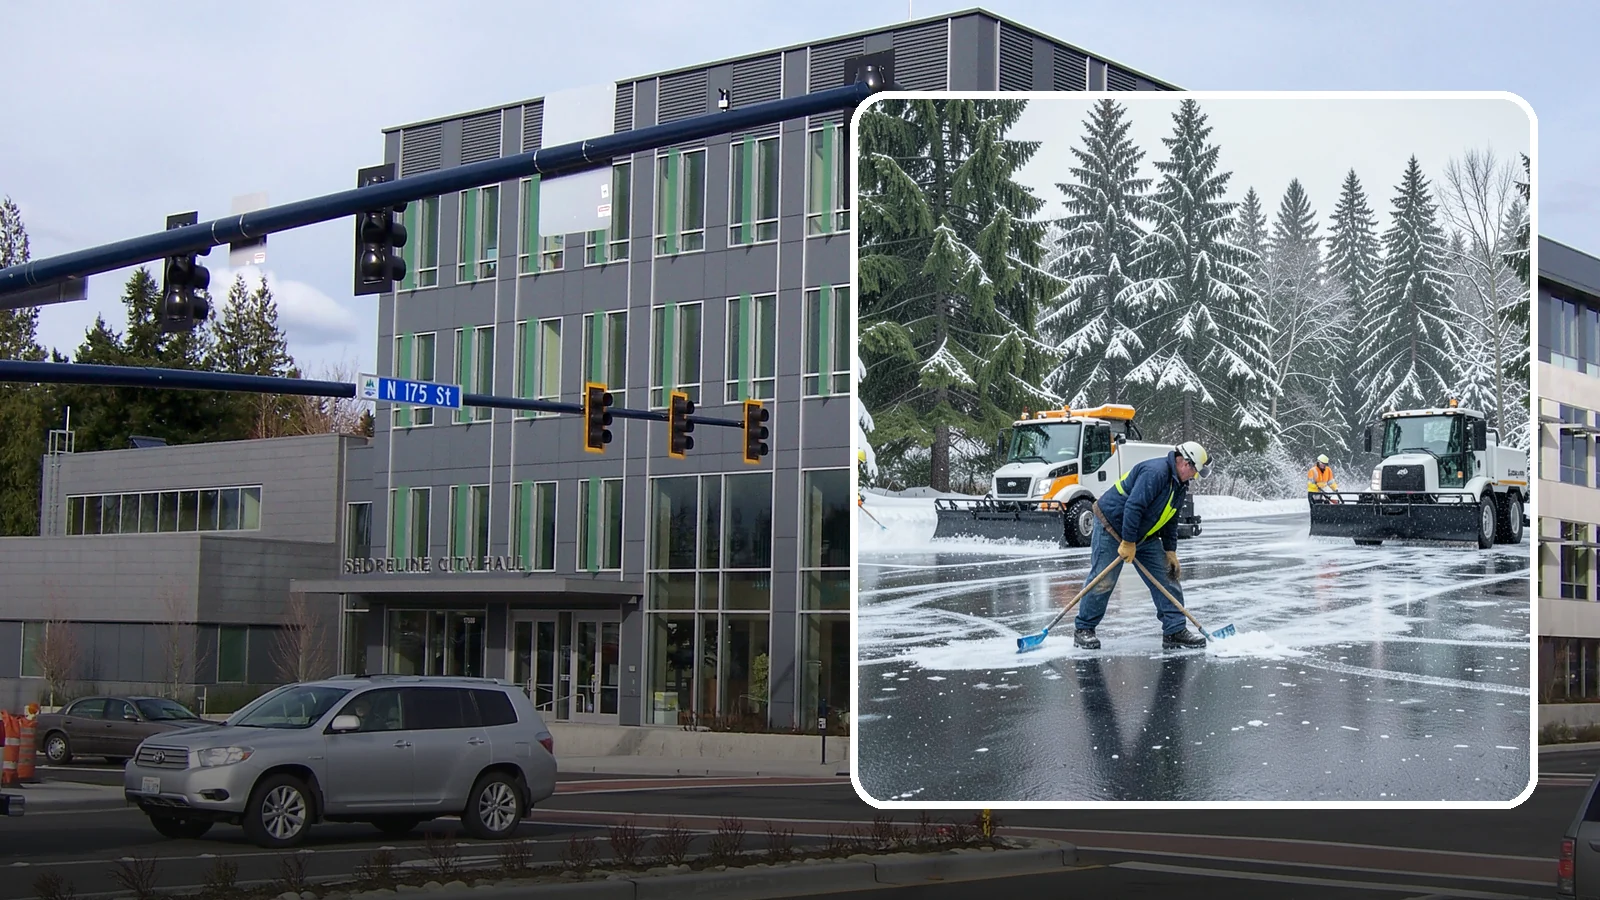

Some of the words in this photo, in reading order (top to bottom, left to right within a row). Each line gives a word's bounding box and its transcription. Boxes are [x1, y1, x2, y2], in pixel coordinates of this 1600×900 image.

[387, 380, 396, 400] N
[404, 382, 428, 403] 175
[436, 386, 452, 406] St
[344, 556, 432, 574] SHORELINE
[438, 556, 475, 572] CITY
[484, 555, 525, 571] HALL
